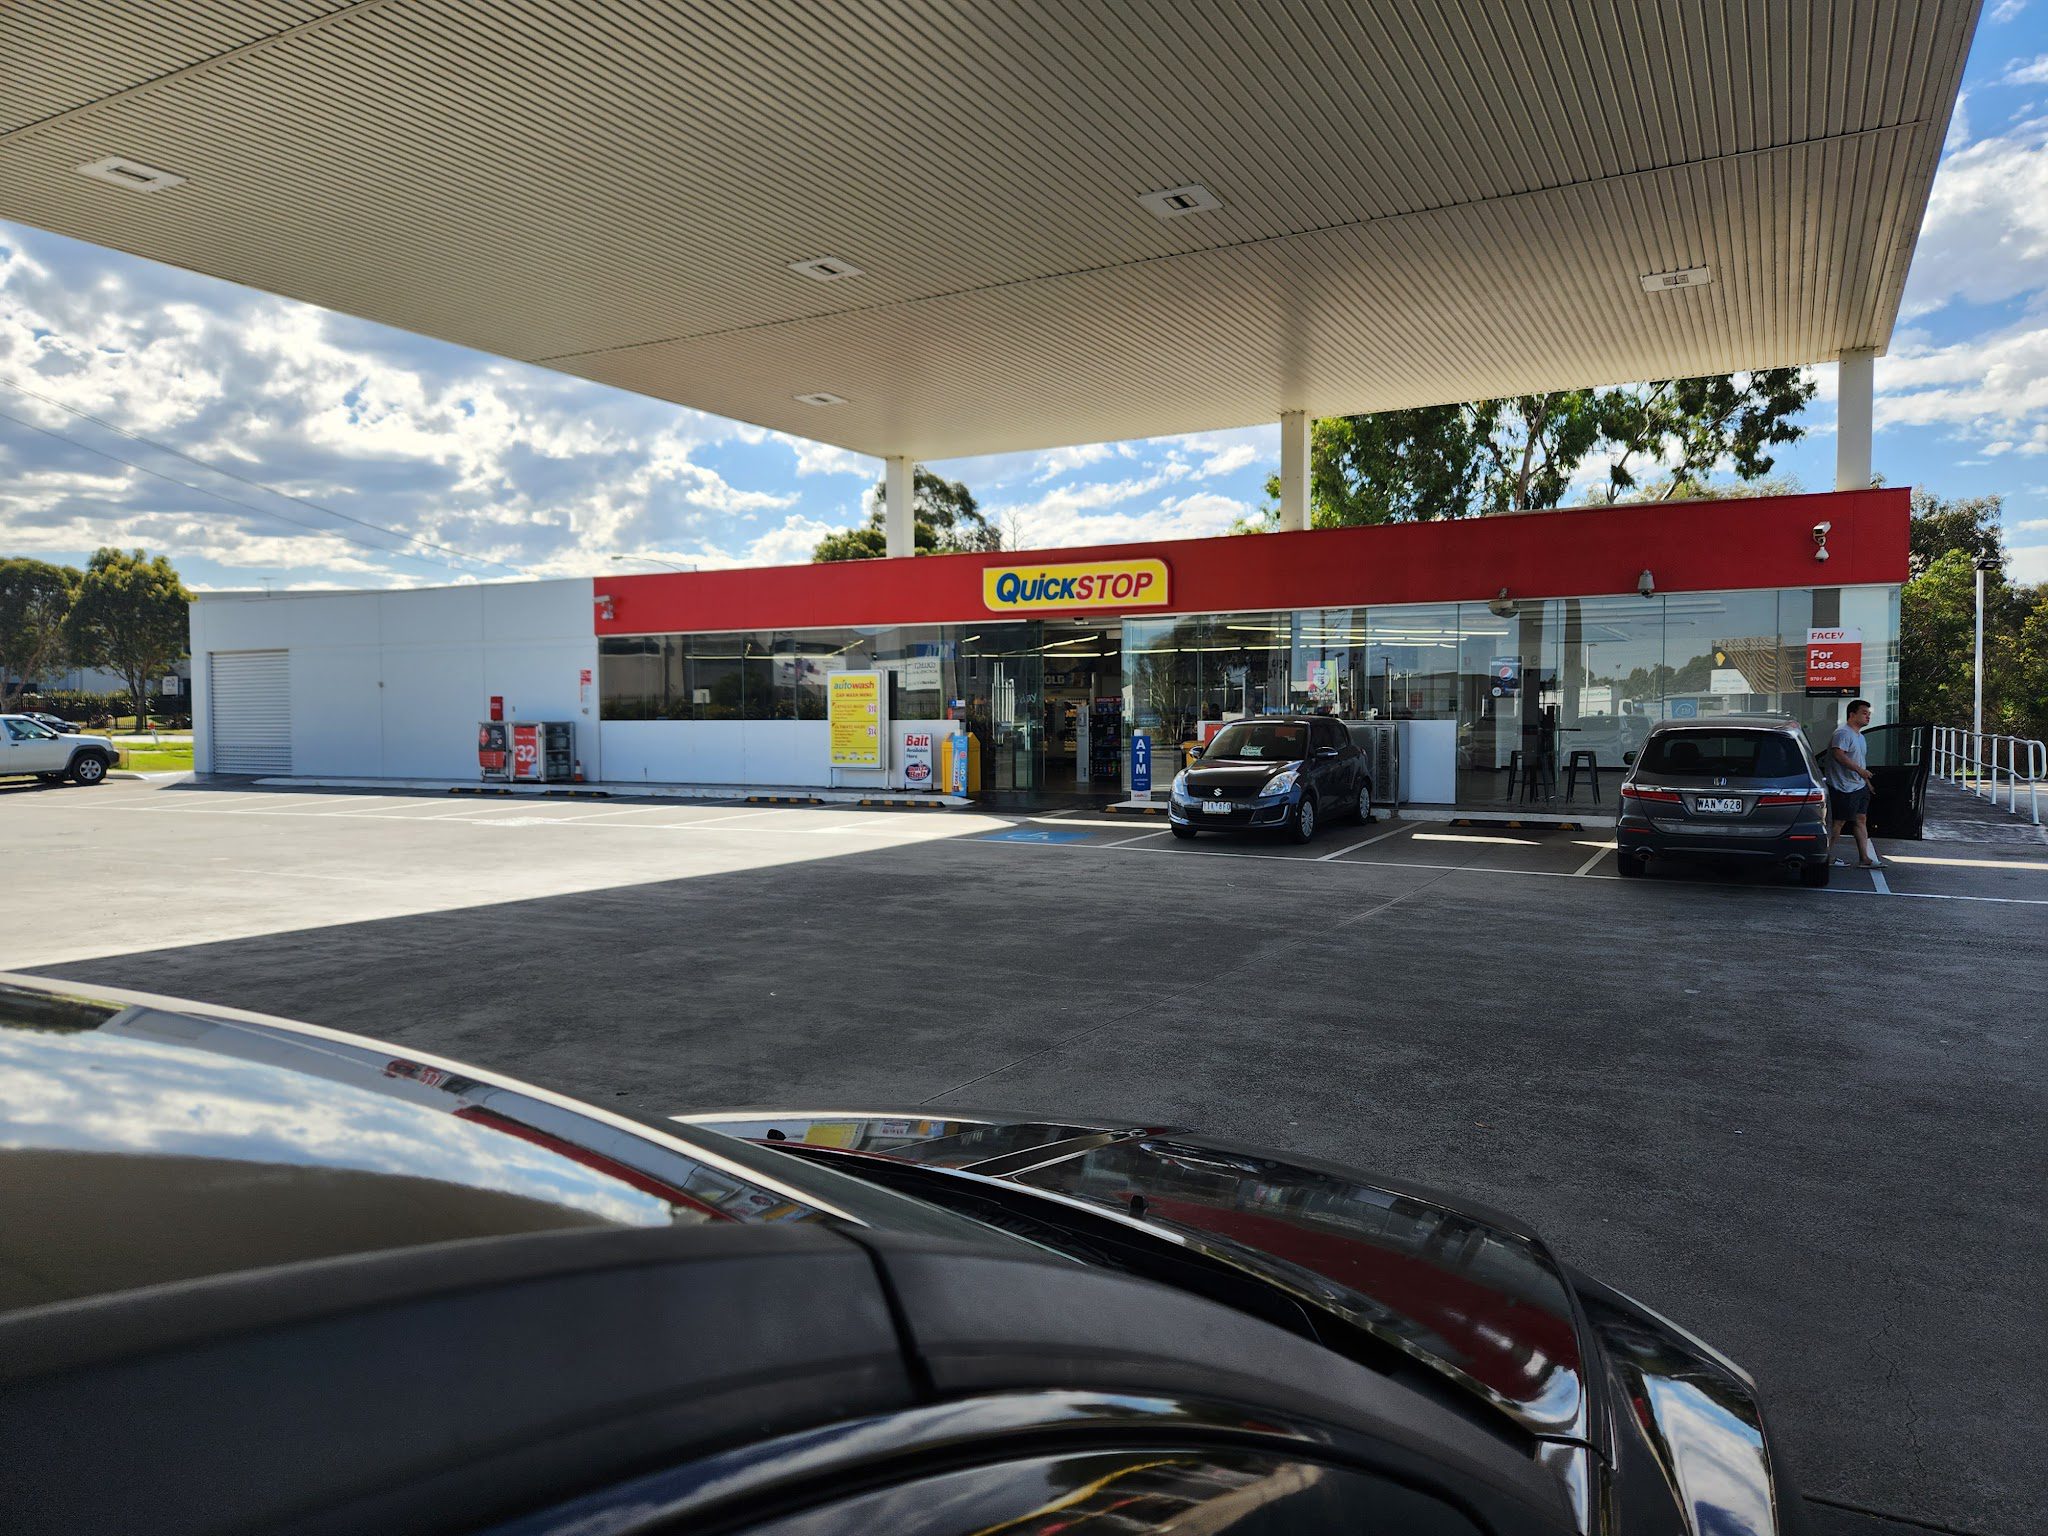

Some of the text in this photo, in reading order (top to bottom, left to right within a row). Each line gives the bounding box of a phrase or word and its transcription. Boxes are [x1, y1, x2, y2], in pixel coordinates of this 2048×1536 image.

[1810, 650, 1833, 659] For
[1810, 660, 1849, 669] Lease
[834, 679, 875, 690] autowash
[906, 735, 929, 746] Bait
[1136, 739, 1146, 774] ATM
[1697, 800, 1741, 809] WAN 628
